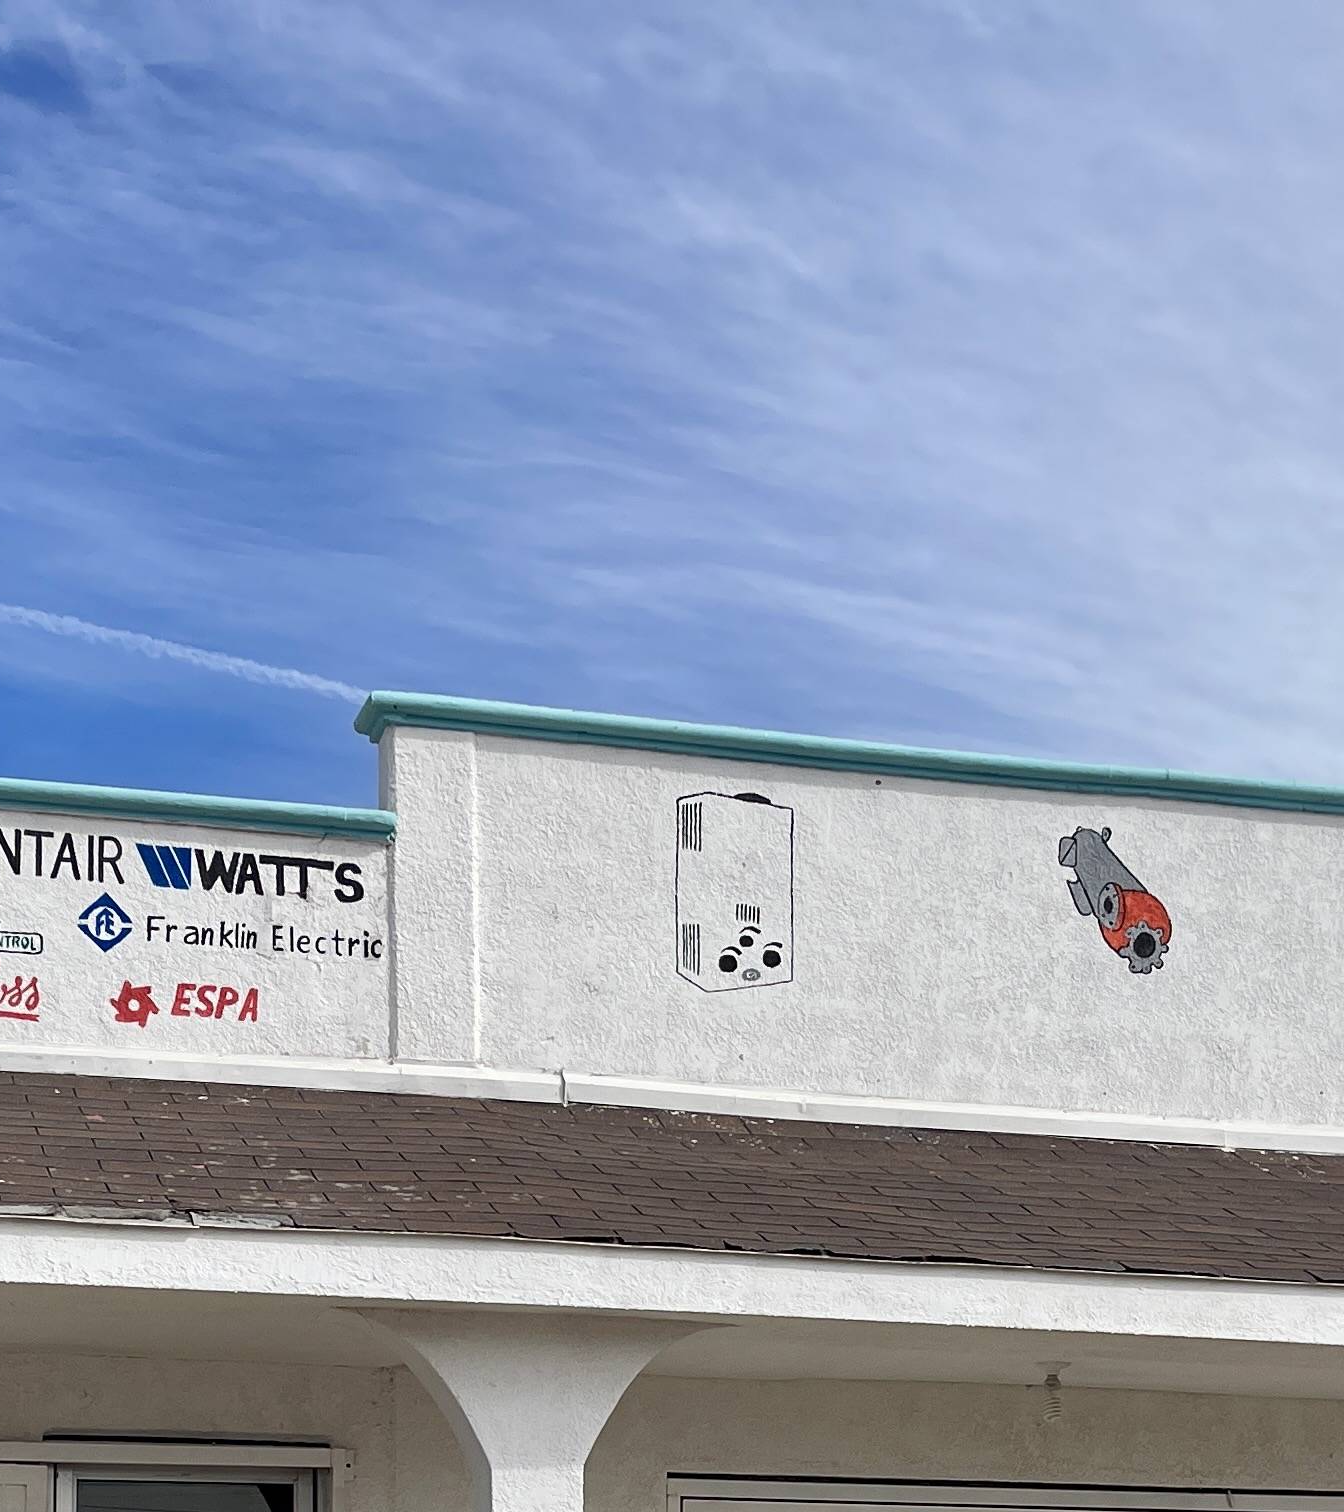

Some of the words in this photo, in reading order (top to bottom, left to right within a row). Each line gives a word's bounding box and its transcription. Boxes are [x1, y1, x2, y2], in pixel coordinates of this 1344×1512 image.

[195, 848, 365, 903] WATTS
[146, 915, 258, 950] Franklin
[272, 924, 383, 959] Electric
[170, 983, 259, 1023] ESPA
